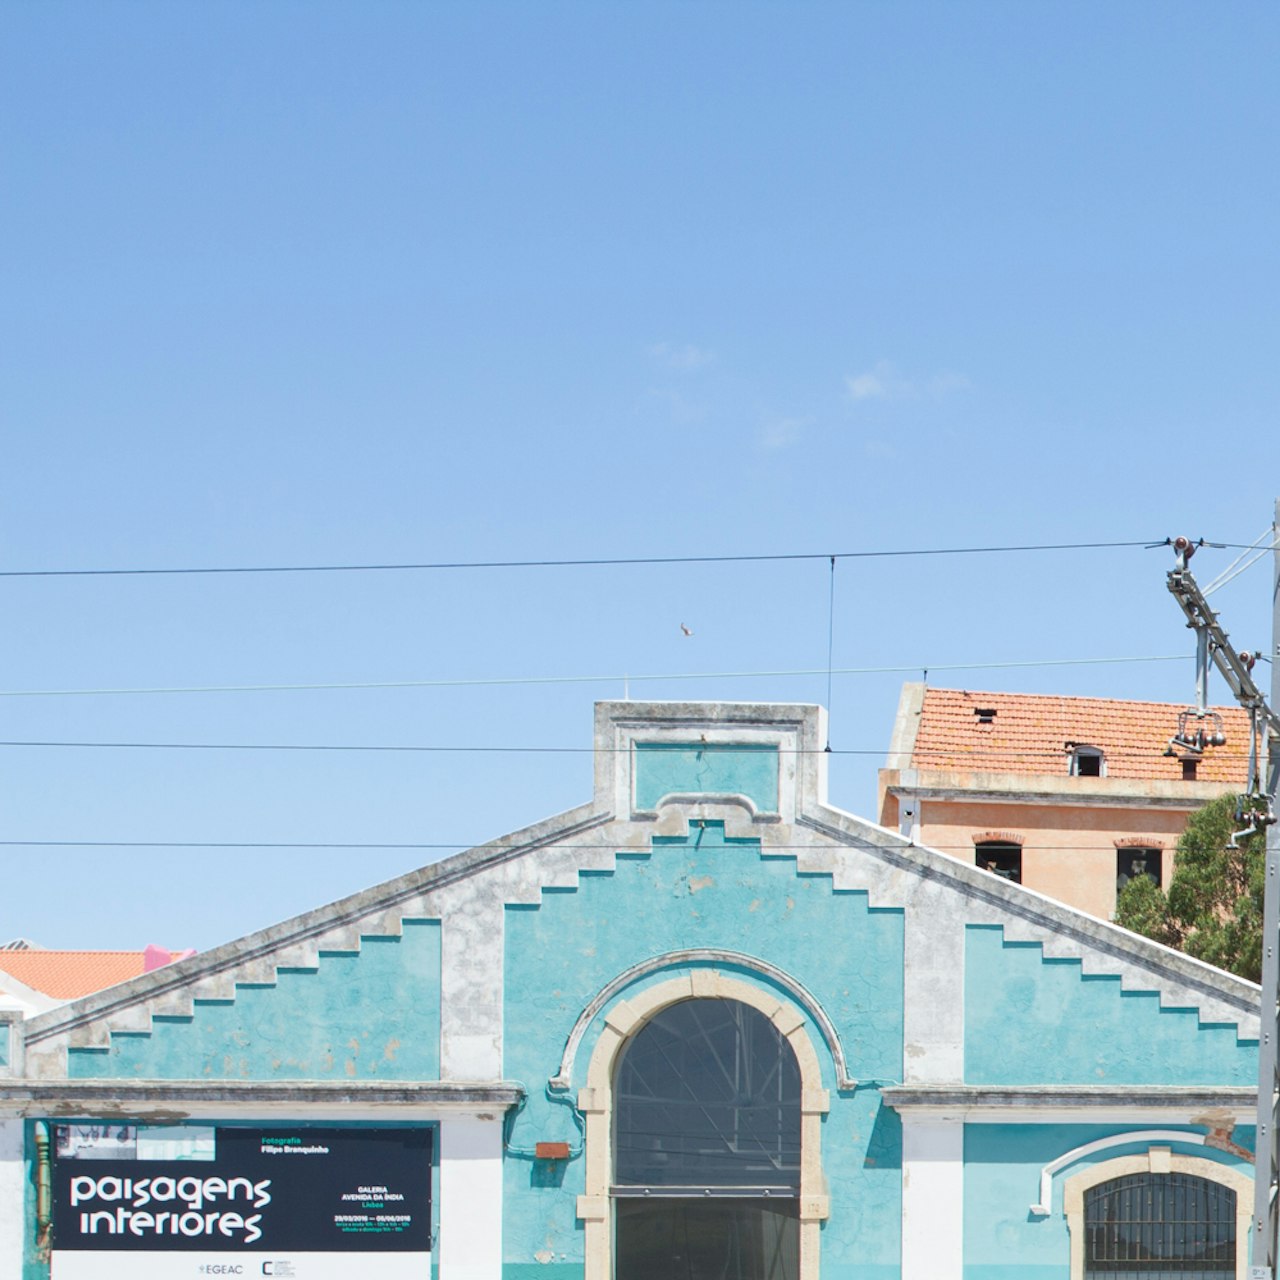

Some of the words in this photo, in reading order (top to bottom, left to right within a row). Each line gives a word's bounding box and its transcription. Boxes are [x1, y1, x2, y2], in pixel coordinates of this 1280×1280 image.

[261, 1136, 301, 1146] Fotografia
[261, 1145, 283, 1155] Filipe
[284, 1145, 329, 1155] Branquinho
[70, 1175, 271, 1209] paisagens
[341, 1193, 372, 1201] AVENIDA
[373, 1193, 384, 1201] DA
[80, 1207, 262, 1243] interiores
[206, 1265, 243, 1274] EGEAC
